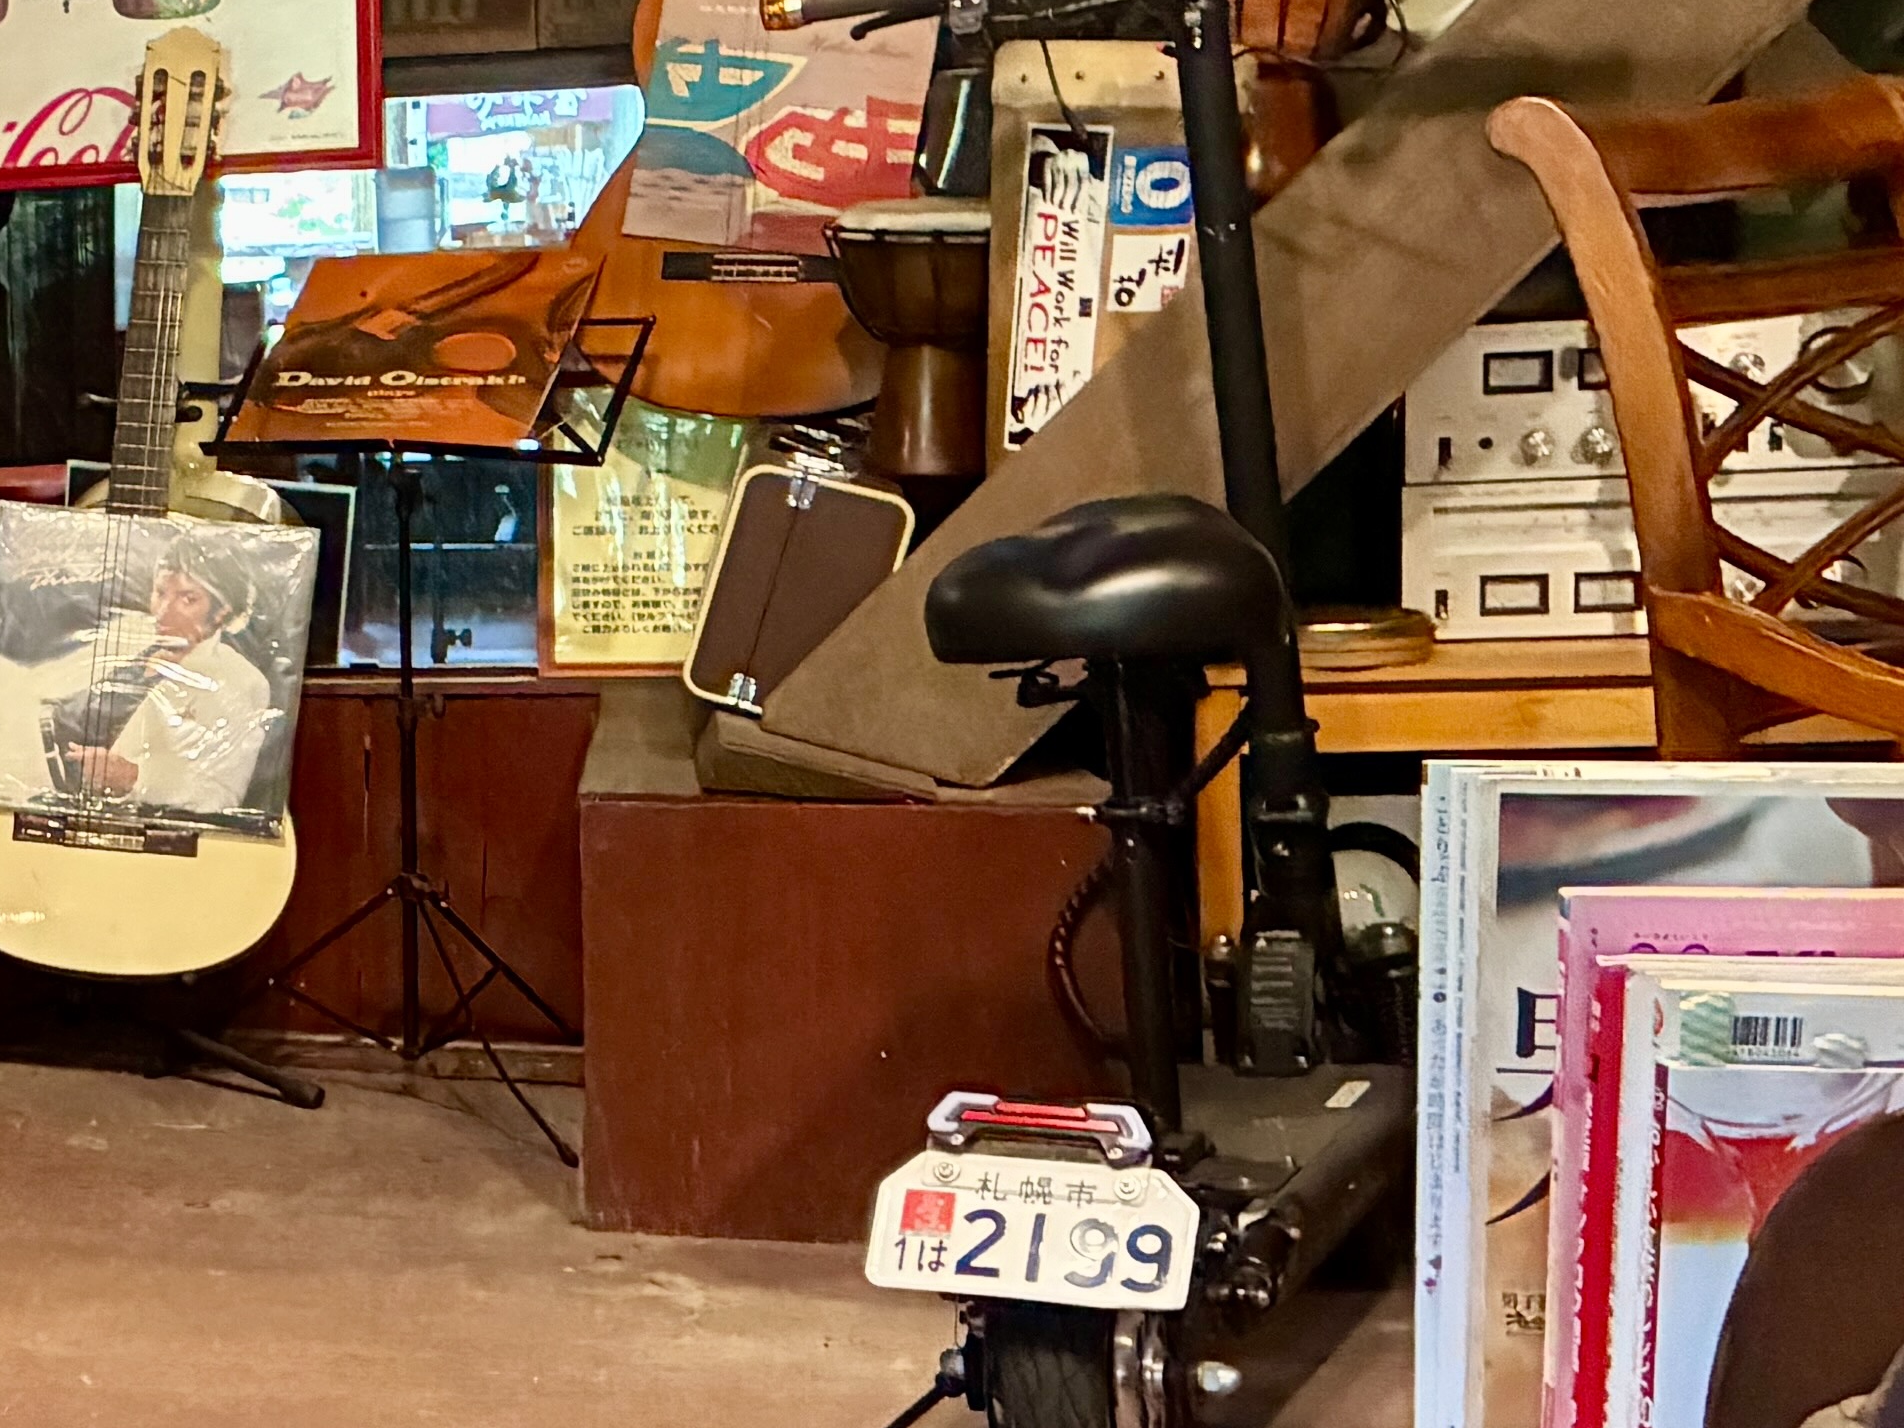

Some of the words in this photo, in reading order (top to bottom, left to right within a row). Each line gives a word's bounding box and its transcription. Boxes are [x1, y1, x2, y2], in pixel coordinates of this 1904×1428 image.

[1058, 219, 1080, 263] Will
[1023, 211, 1059, 374] PEACE!
[1053, 270, 1075, 326] Work
[1048, 334, 1070, 375] for
[275, 370, 373, 387] David
[975, 1171, 1098, 1209] 札幌市
[954, 1208, 1174, 1294] 2199
